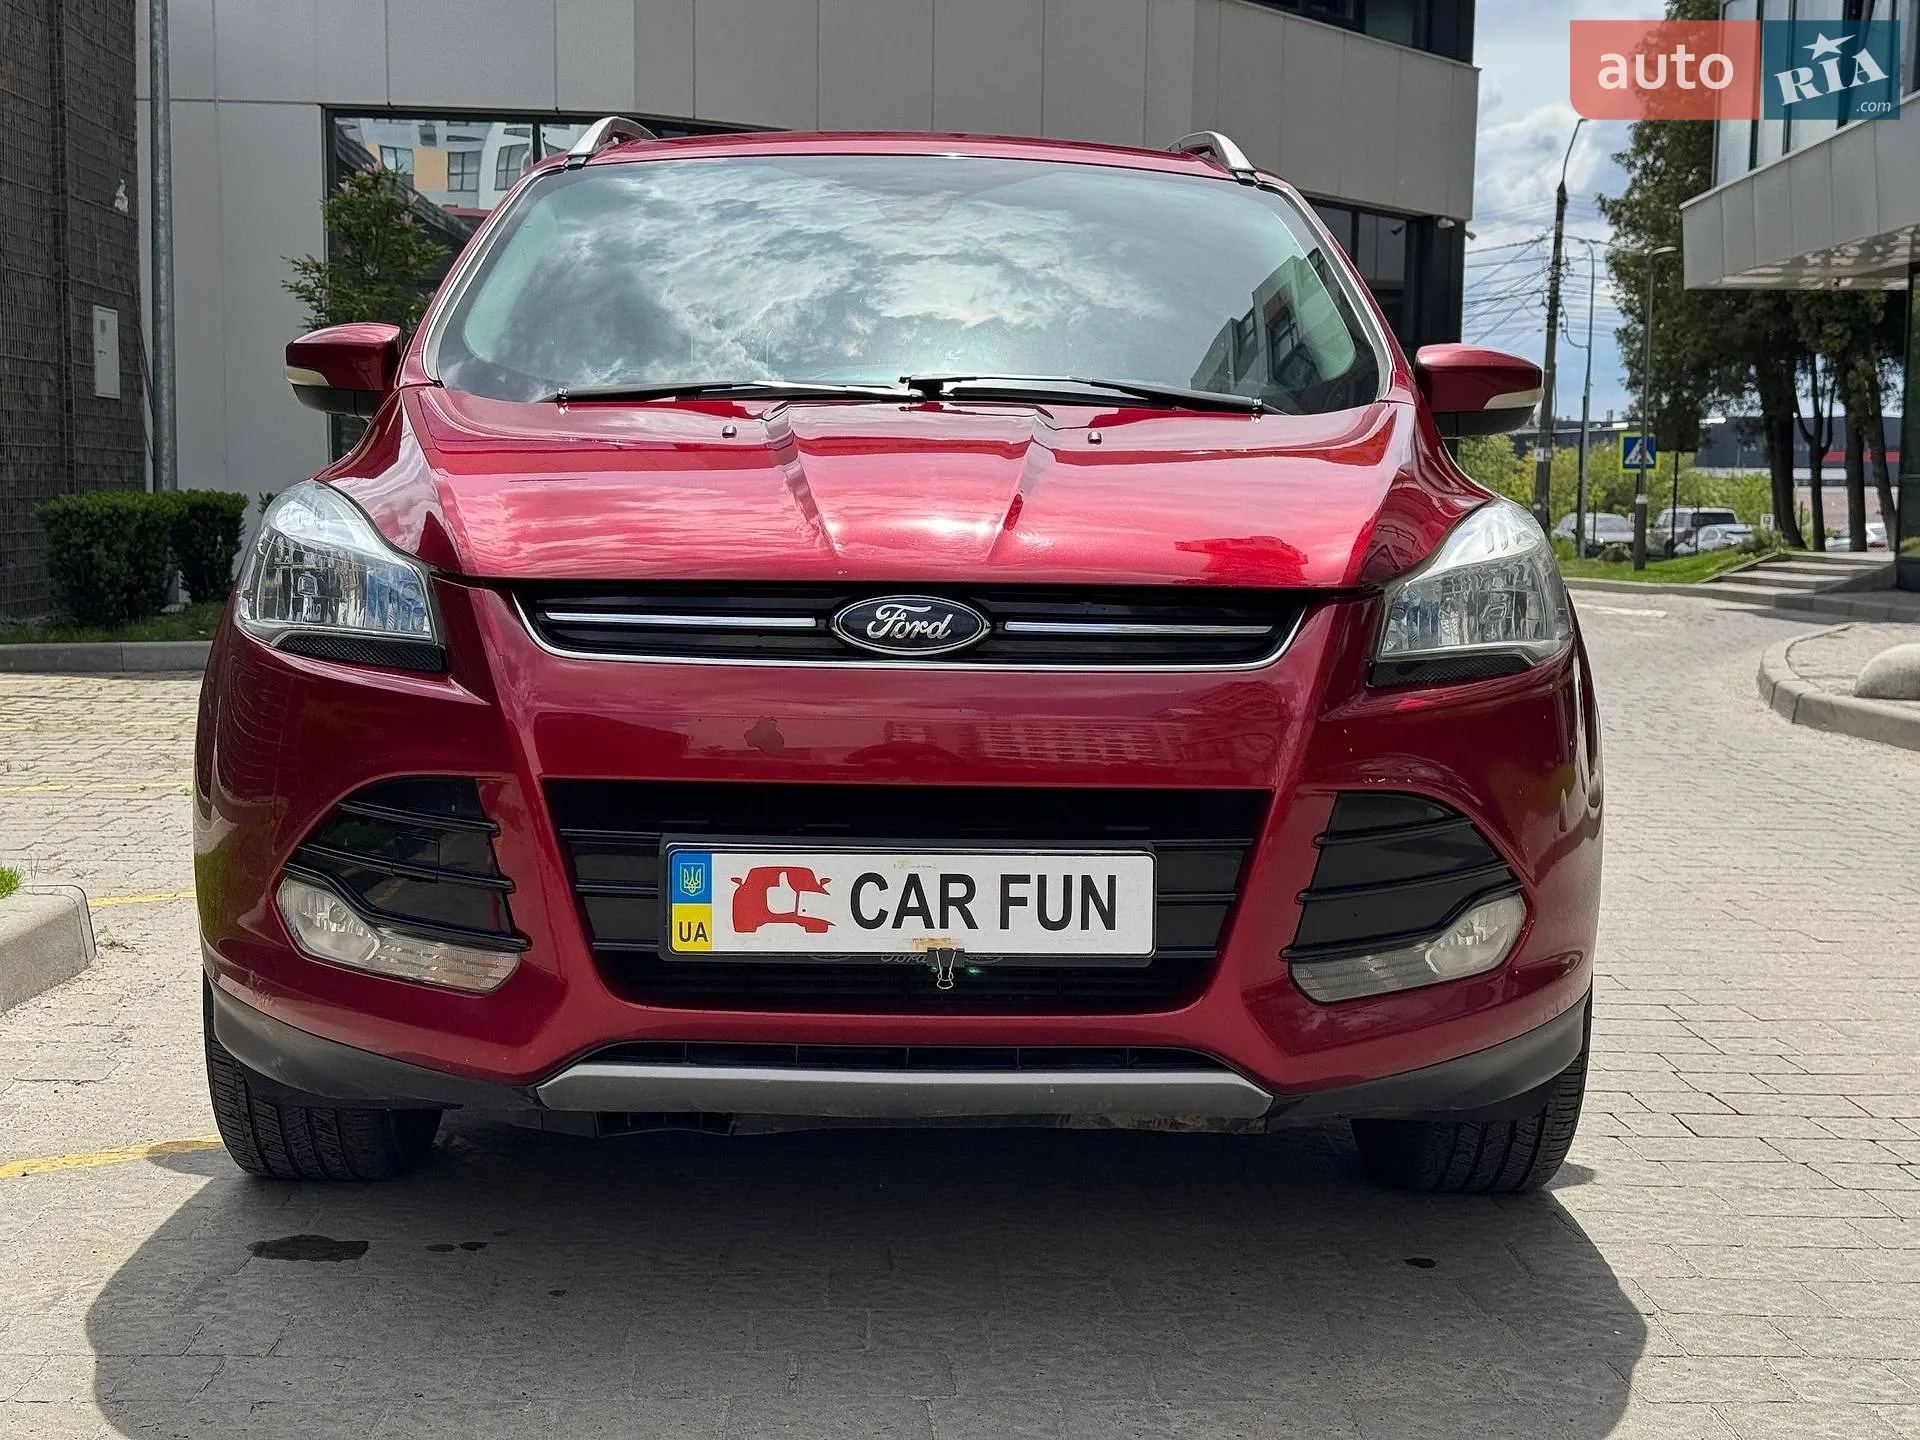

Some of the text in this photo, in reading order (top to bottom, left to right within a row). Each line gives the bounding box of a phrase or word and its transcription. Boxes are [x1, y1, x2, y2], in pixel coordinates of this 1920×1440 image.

[866, 604, 953, 639] Ford
[850, 872, 1117, 931] CAR FUN
[679, 921, 709, 942] UA
